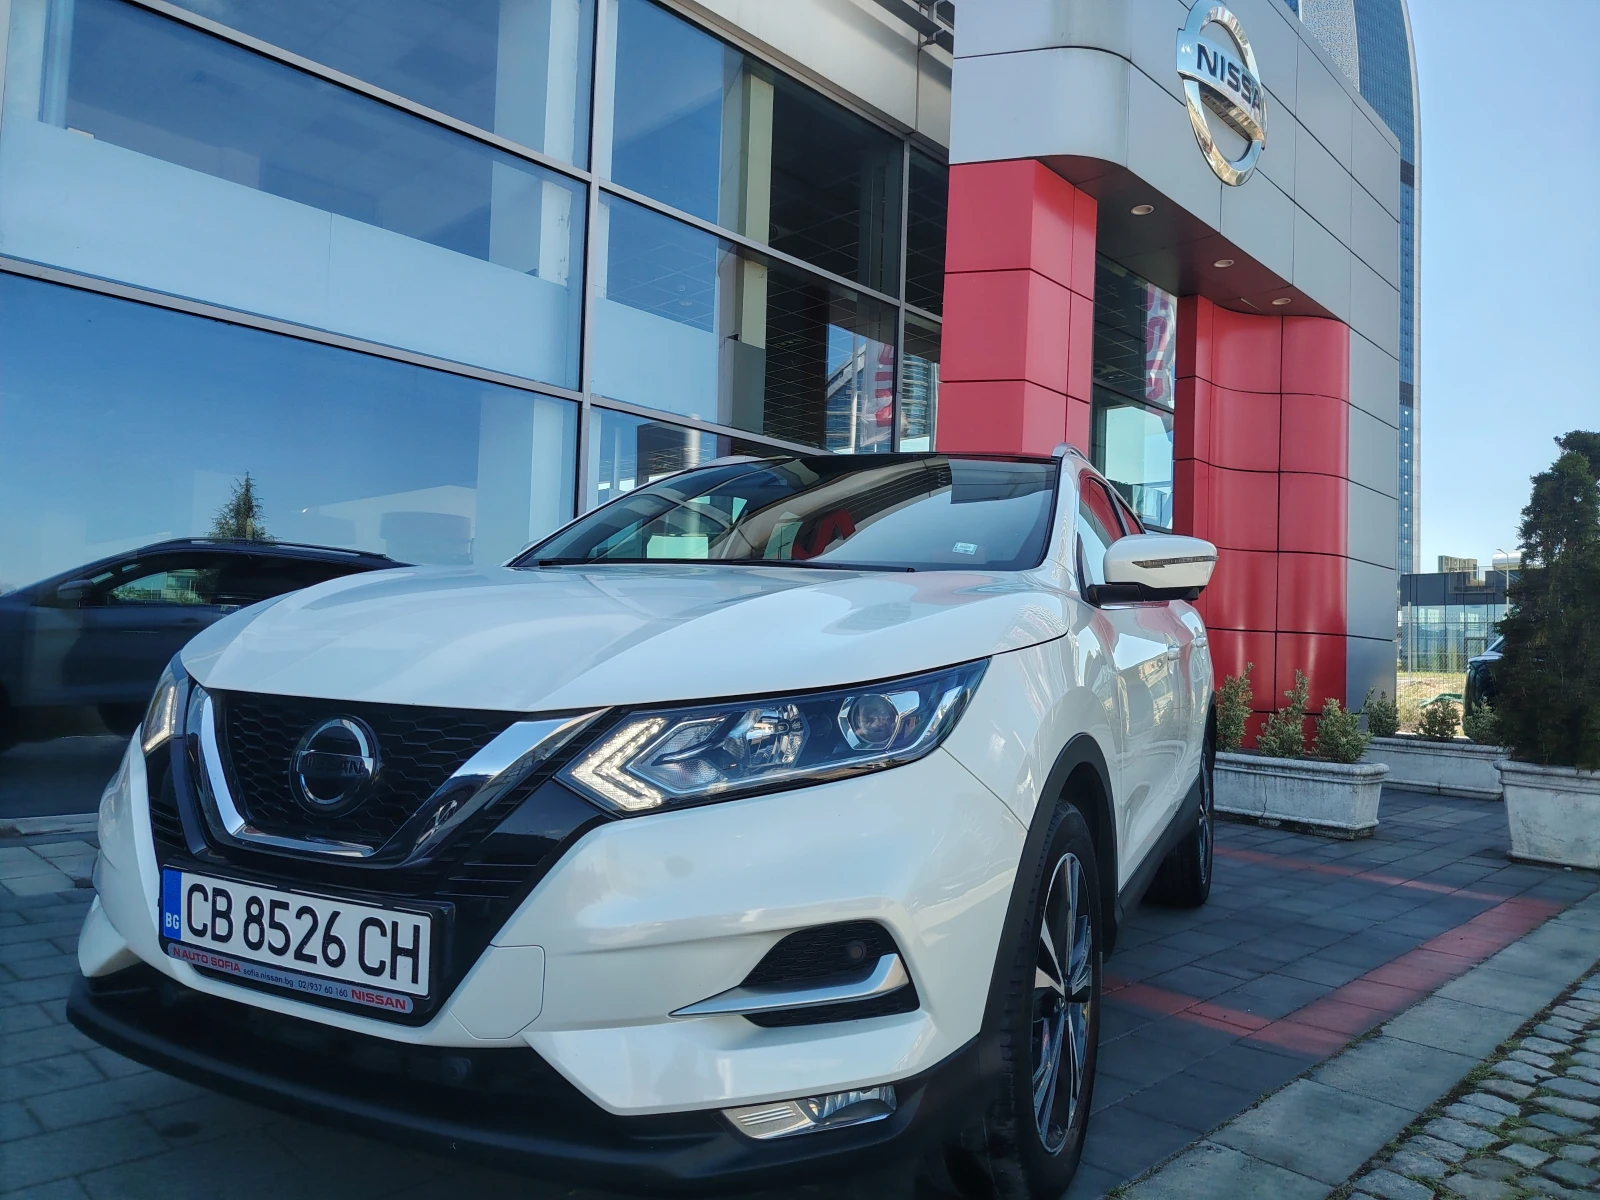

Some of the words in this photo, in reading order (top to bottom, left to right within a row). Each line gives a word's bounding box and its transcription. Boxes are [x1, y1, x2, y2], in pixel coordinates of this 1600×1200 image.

[1197, 43, 1261, 111] NISSA
[165, 912, 180, 930] BG
[186, 883, 234, 943] CB
[243, 895, 347, 968] 8526
[358, 916, 421, 985] CH
[211, 957, 241, 972] SOFIA
[243, 968, 294, 987] sofia.nissan.bg
[298, 979, 322, 992] 02/937
[324, 985, 334, 995] 60
[335, 987, 348, 998] 160
[351, 989, 406, 1010] NISSAN
